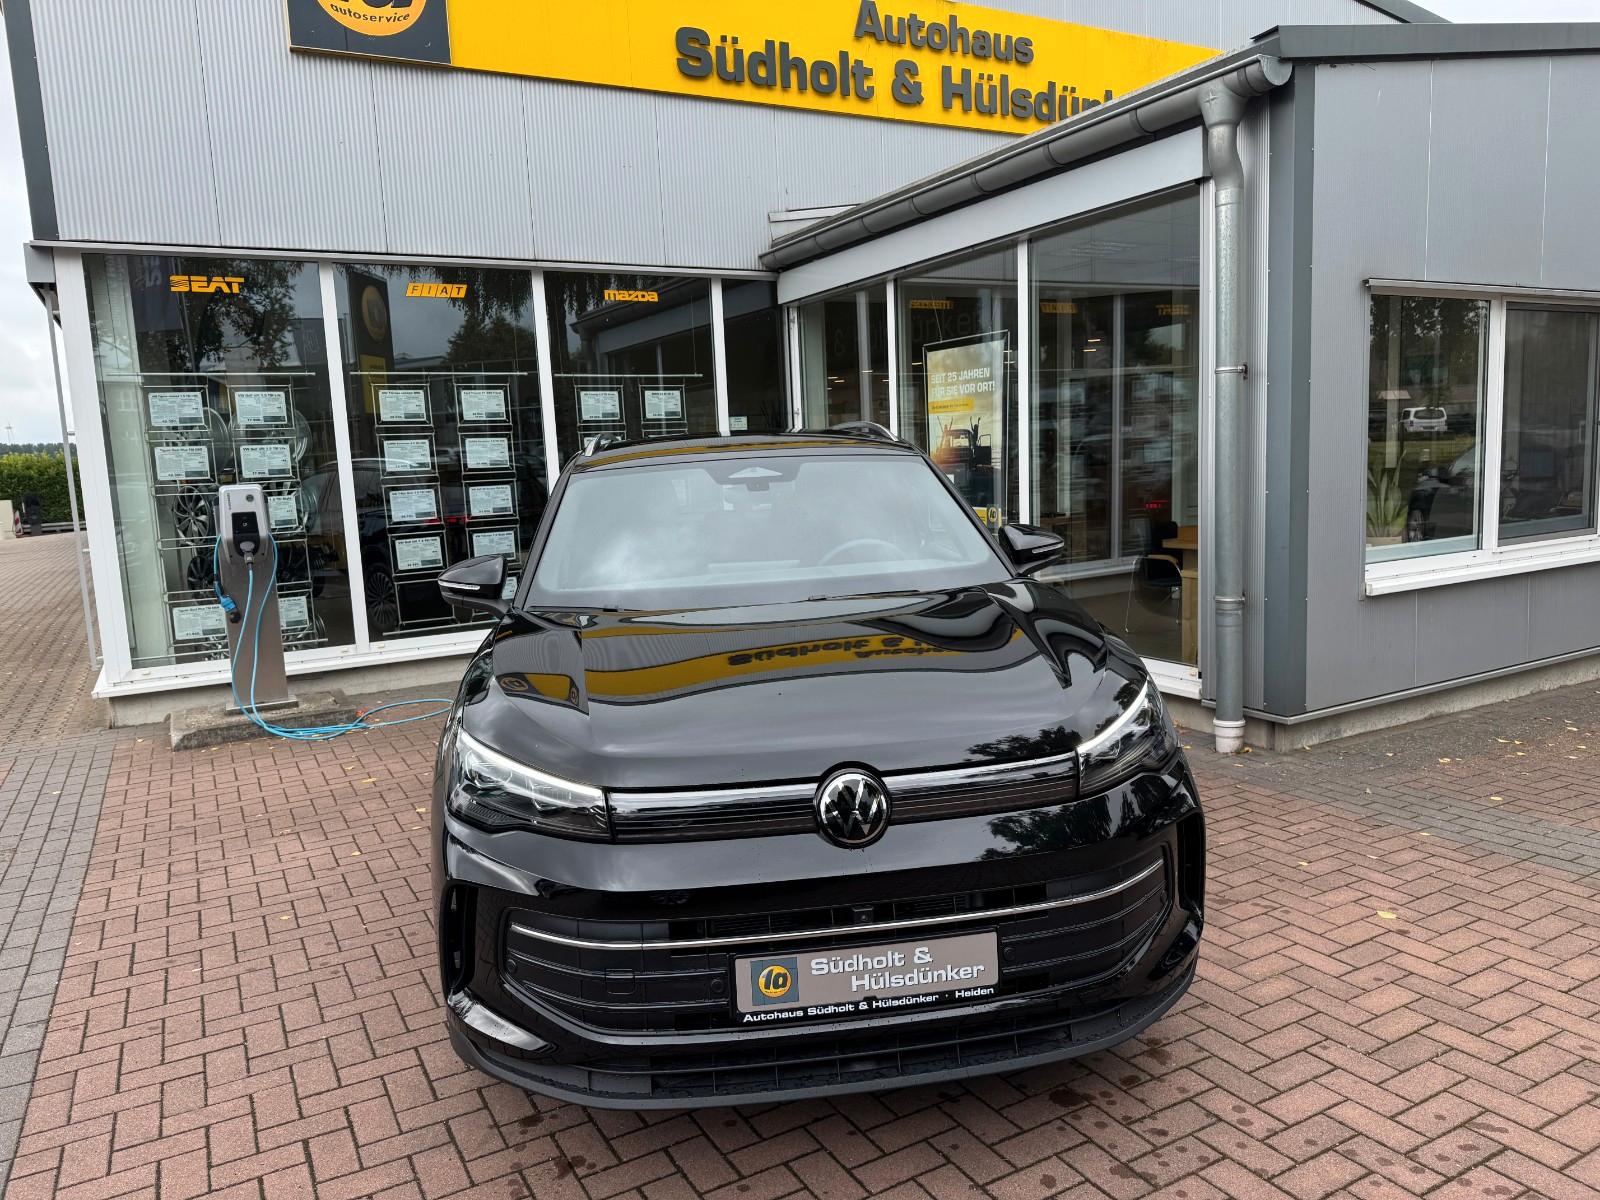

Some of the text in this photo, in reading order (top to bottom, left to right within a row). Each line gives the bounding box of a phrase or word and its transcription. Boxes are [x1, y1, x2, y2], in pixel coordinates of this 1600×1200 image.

[330, 4, 410, 23] autoservice
[854, 0, 1035, 64] Autohaus
[675, 26, 875, 100] Südholt
[892, 59, 925, 105] &
[170, 275, 245, 294] SEAT
[408, 283, 466, 297] FIAT
[604, 289, 659, 302] mazda
[931, 373, 946, 384] SEIT
[959, 367, 991, 380] JAHREN
[946, 385, 959, 396] SIE
[959, 383, 976, 394] VOR
[977, 380, 996, 393] ORT!
[810, 946, 933, 976] Südholt &
[850, 963, 985, 992] Hülsdünker
[743, 987, 995, 1023] Autohaus Südholt & Hülsdünker Heiden
